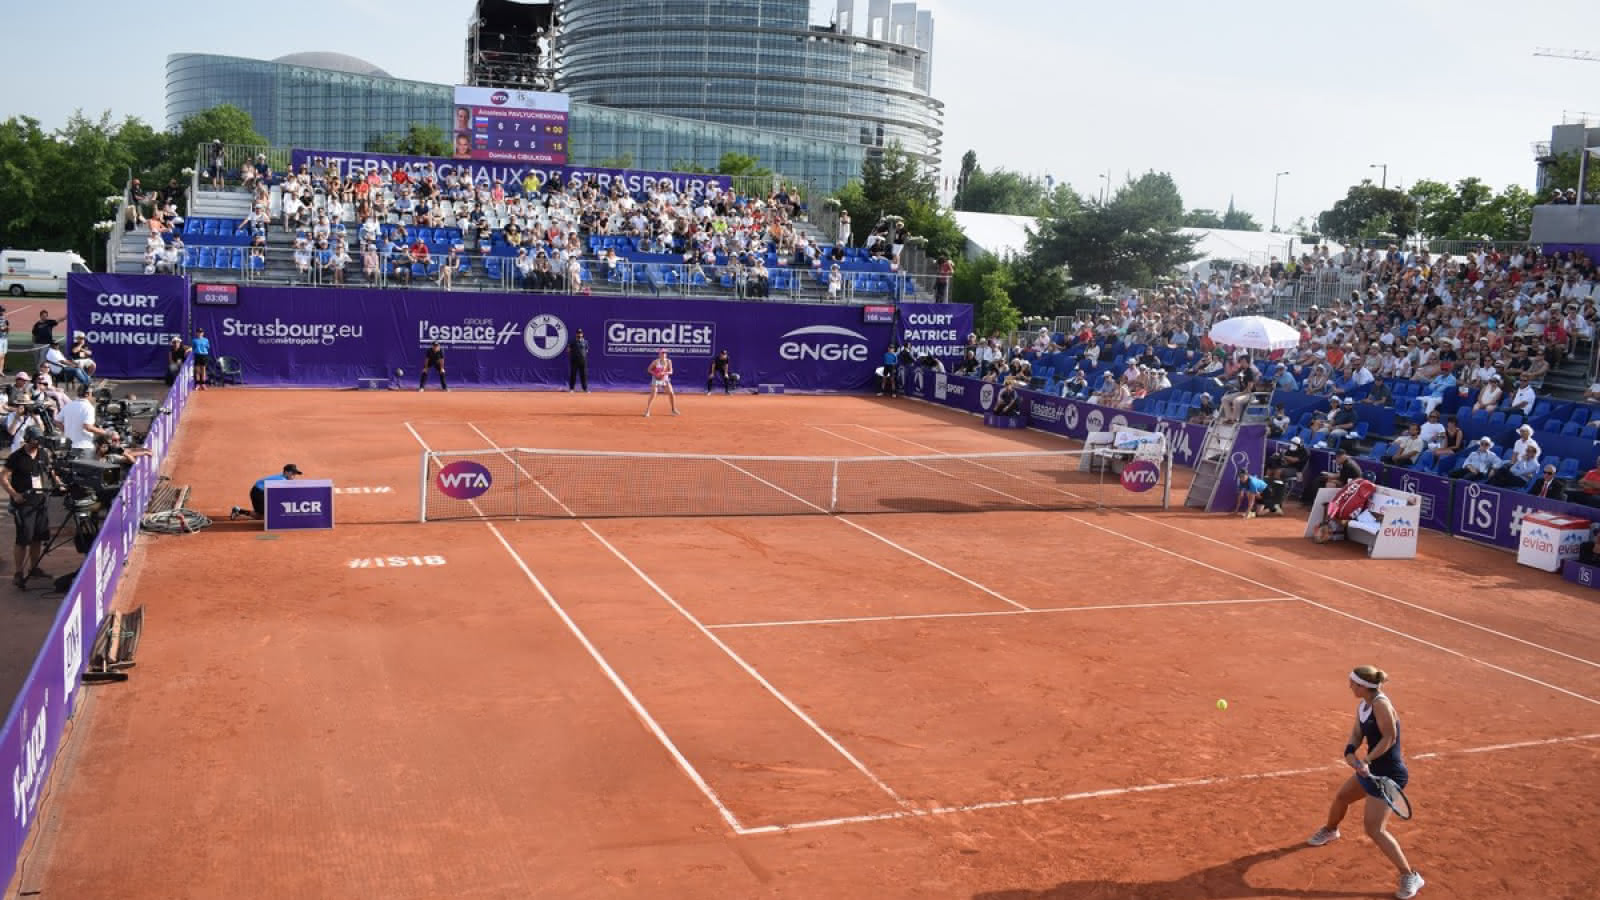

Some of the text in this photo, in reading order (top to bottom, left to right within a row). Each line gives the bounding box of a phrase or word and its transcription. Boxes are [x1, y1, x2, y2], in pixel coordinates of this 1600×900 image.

[508, 111, 565, 121] PAVLYUCHENKOVA
[515, 123, 520, 131] 7
[531, 124, 537, 132] 4
[514, 140, 520, 148] 6
[530, 141, 536, 149] 5
[97, 293, 159, 308] COURT
[91, 311, 165, 327] PATRICE
[908, 314, 953, 325] COURT
[223, 318, 363, 346] Strasbourg.eu
[419, 320, 495, 344] l'espace
[904, 329, 957, 341] PATRICE
[439, 473, 489, 488] WTA
[1123, 471, 1157, 483] WTA
[1383, 526, 1415, 537] evian
[1522, 536, 1554, 553] evian
